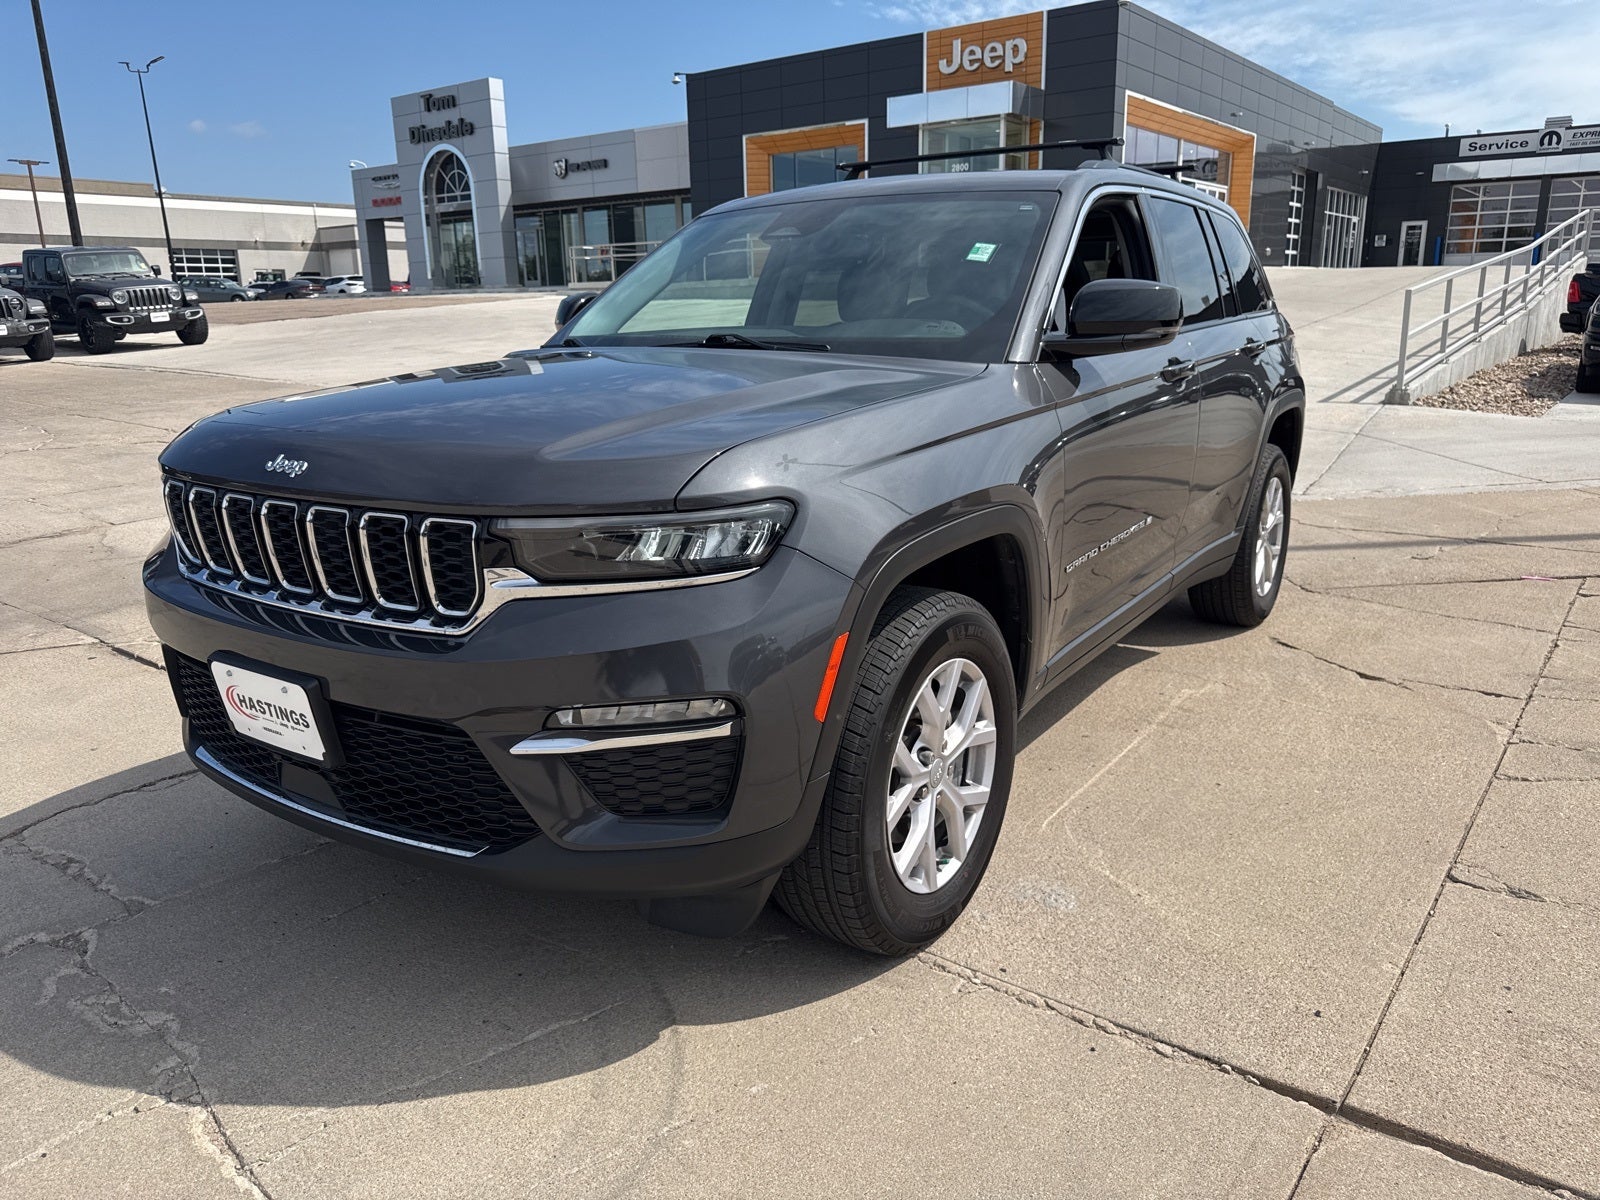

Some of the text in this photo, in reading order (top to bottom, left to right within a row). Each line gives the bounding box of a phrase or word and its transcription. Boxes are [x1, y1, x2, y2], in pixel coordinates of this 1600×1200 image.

[938, 37, 1027, 75] Jeep
[420, 93, 457, 112] Tom
[408, 117, 474, 144] Dinsdale
[1467, 139, 1529, 152] Service
[951, 162, 969, 173] 2800
[265, 453, 309, 478] Jeep
[1065, 519, 1146, 574] GRAND CHEROKEE
[236, 693, 311, 729] HASTINGS
